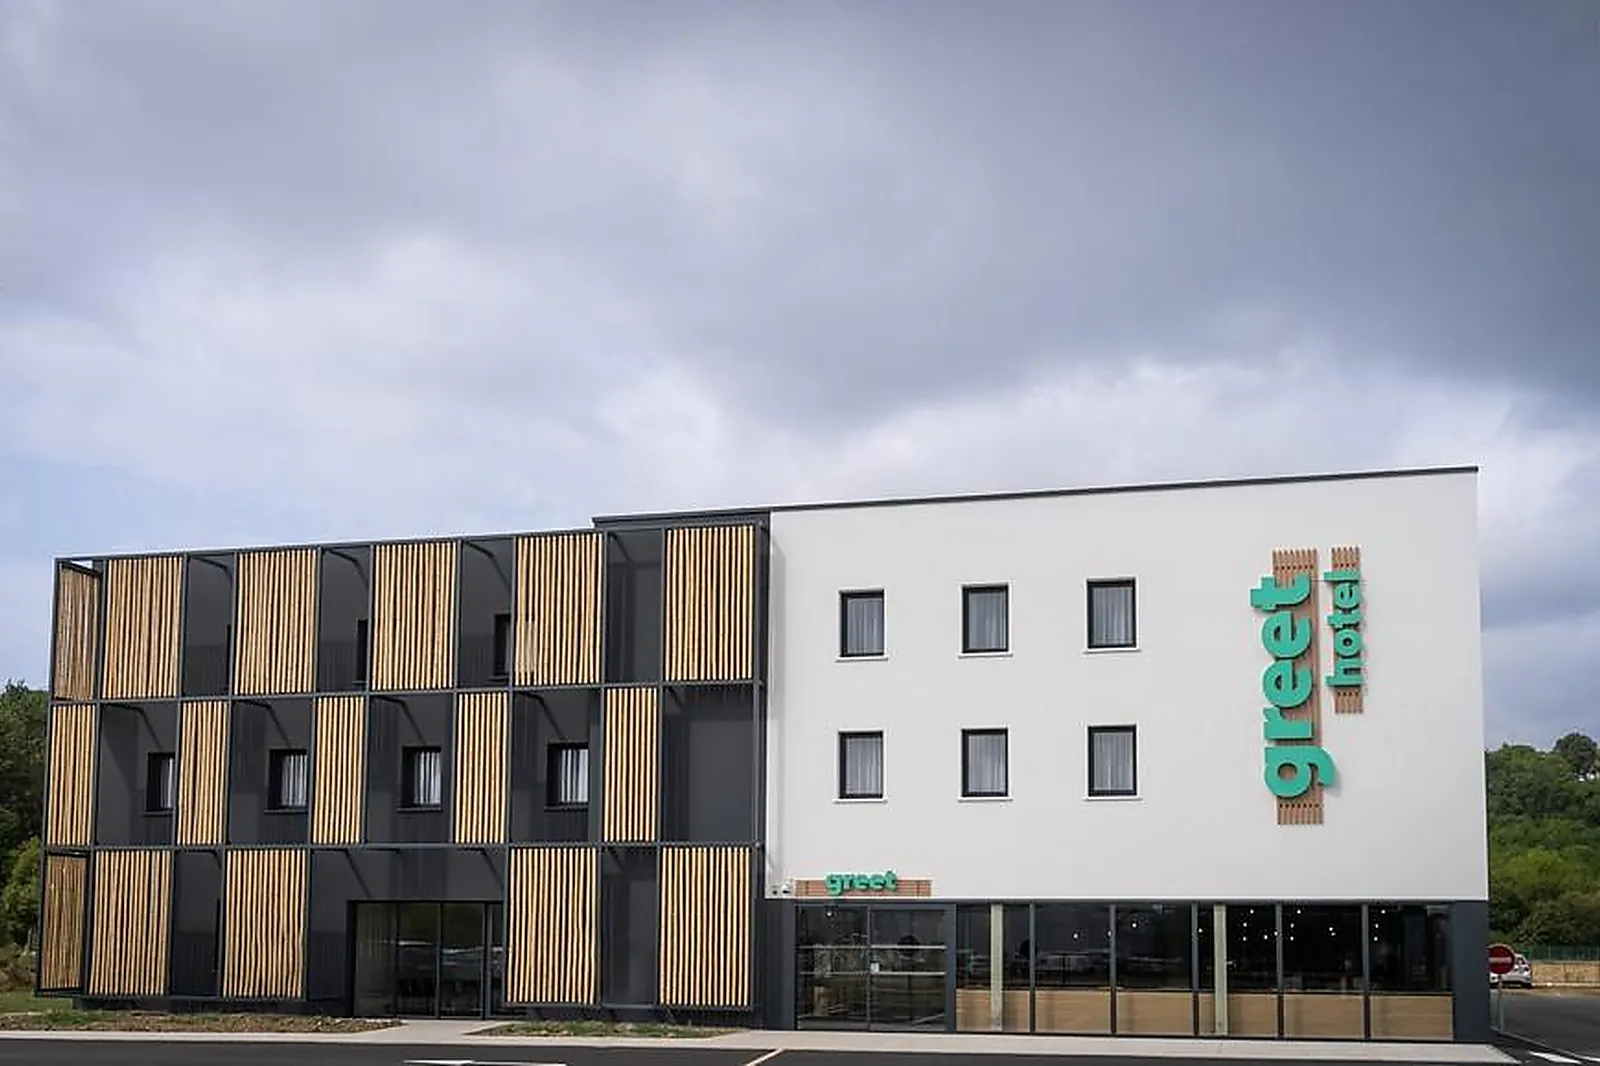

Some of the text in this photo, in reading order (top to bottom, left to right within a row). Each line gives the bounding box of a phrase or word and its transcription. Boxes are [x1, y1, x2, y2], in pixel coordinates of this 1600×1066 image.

[1250, 573, 1336, 798] greet
[1324, 570, 1364, 688] hotel
[825, 870, 898, 896] greet
